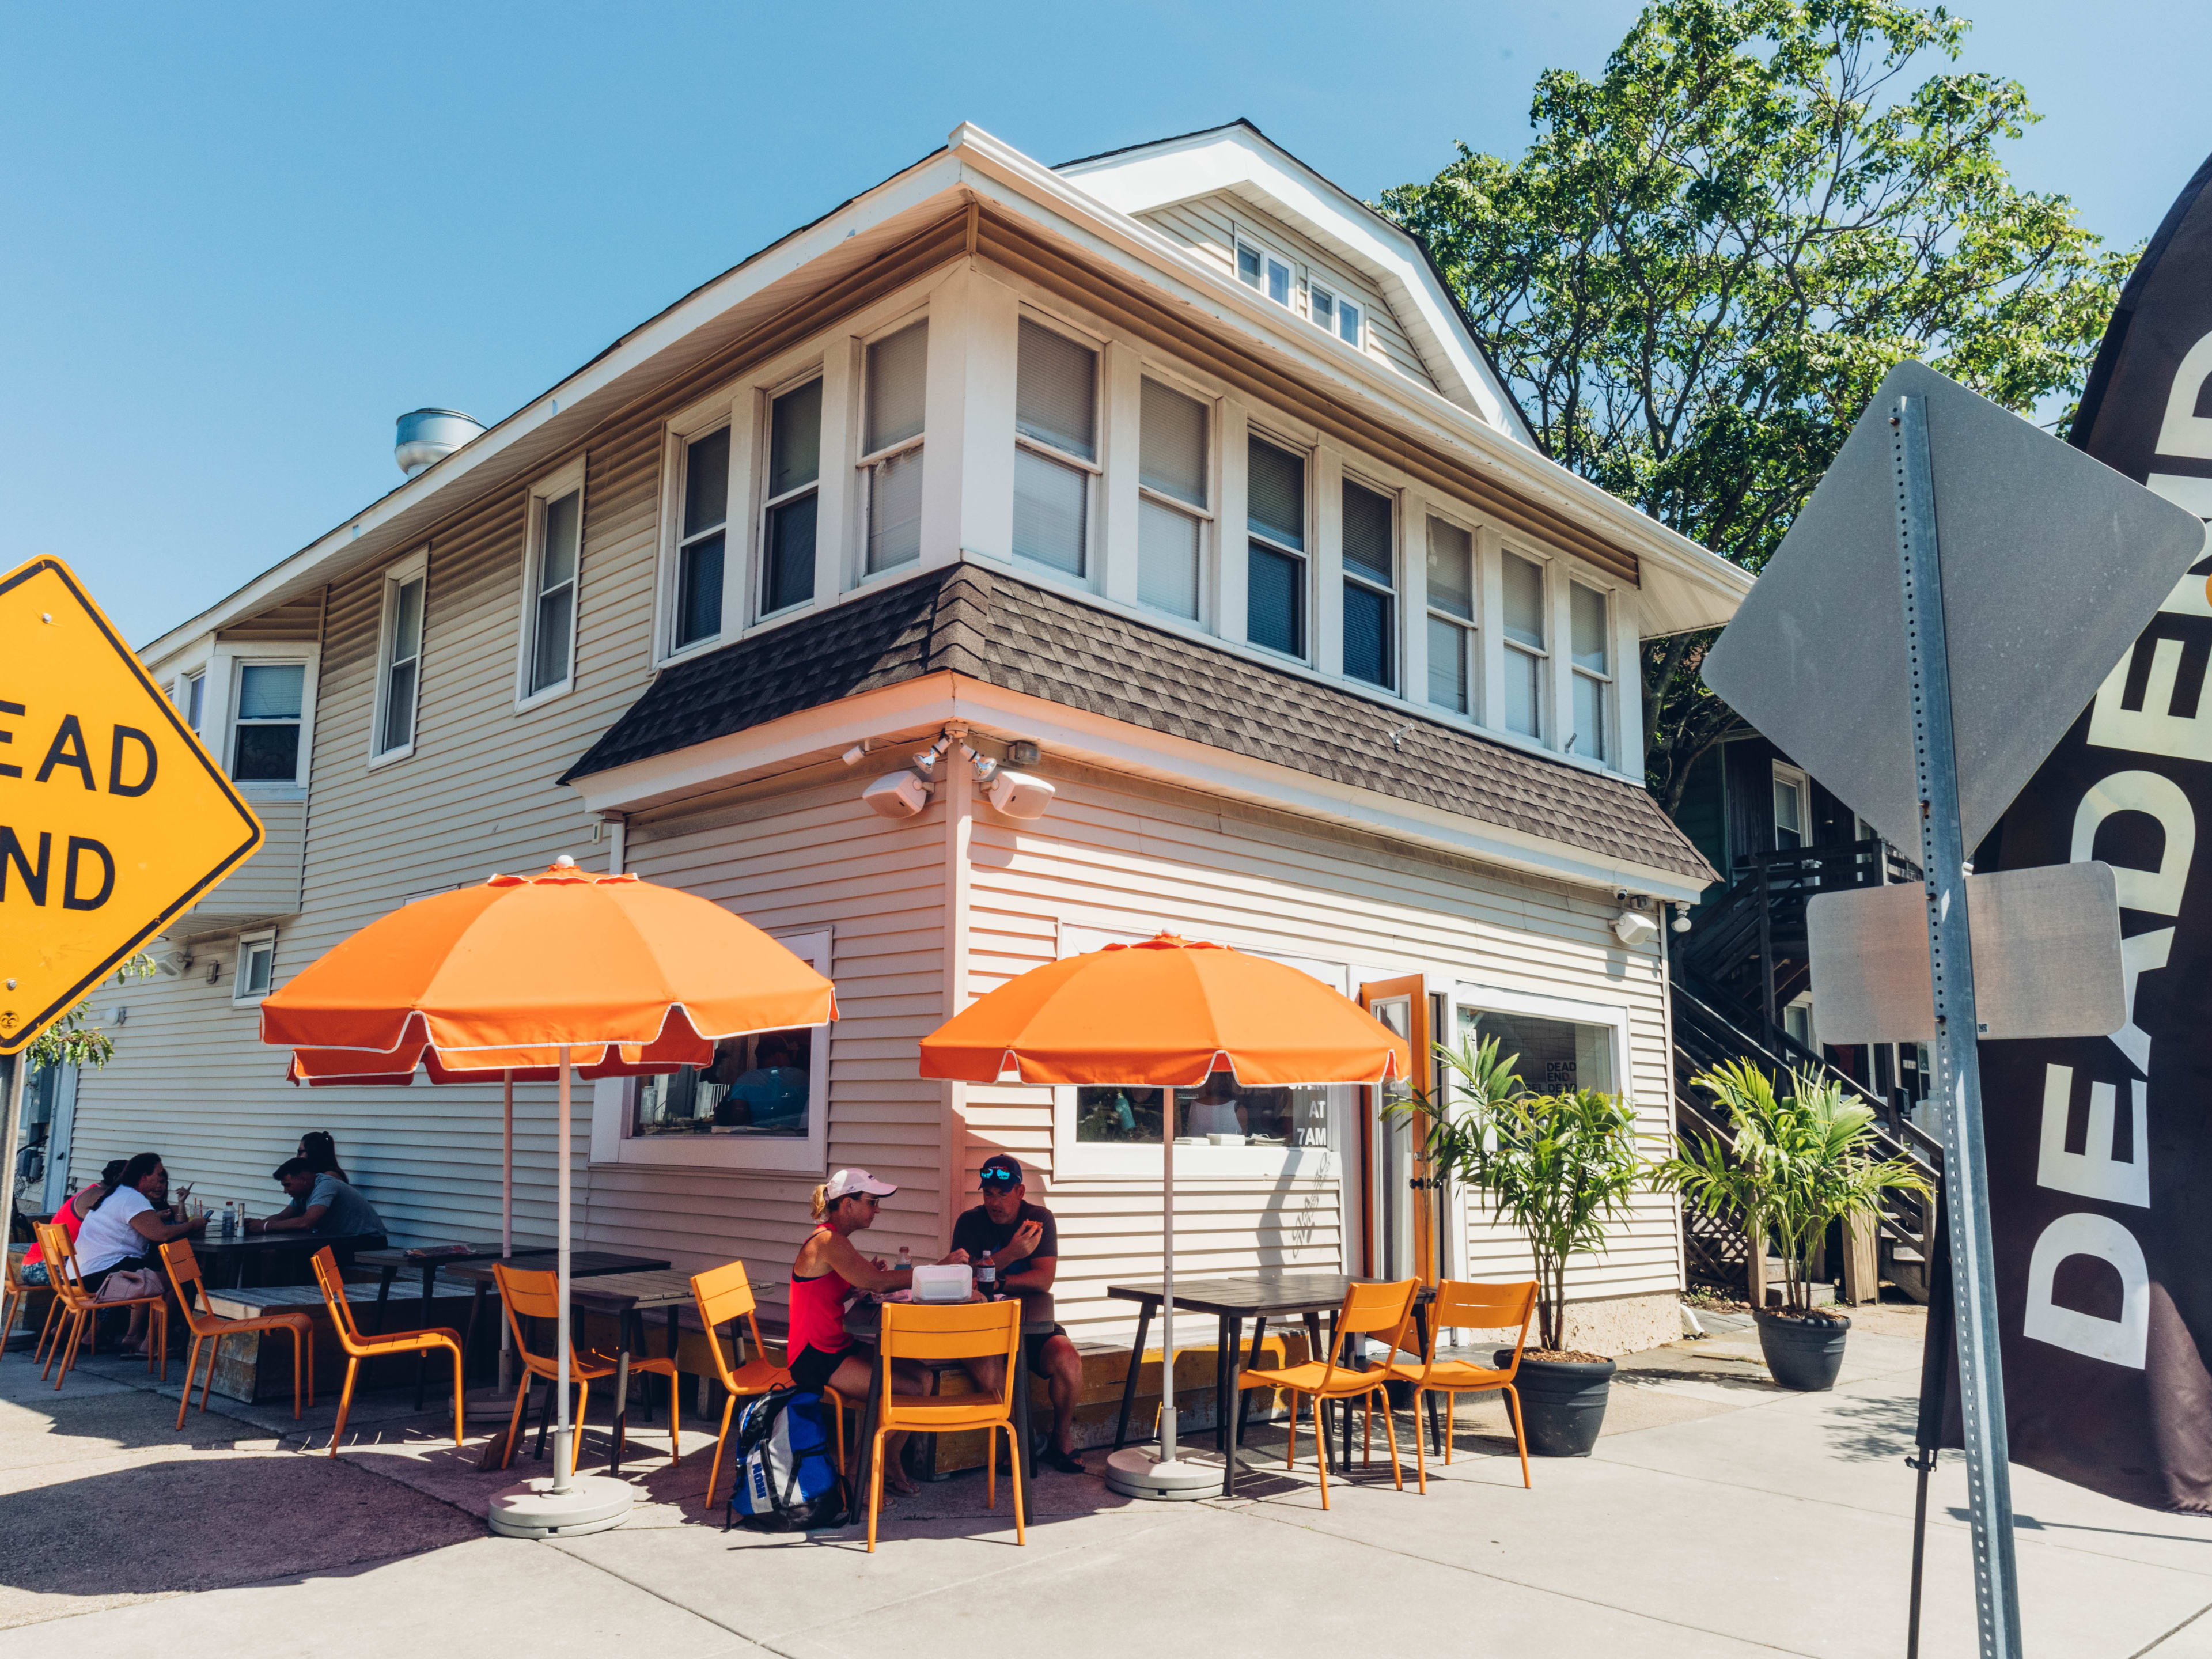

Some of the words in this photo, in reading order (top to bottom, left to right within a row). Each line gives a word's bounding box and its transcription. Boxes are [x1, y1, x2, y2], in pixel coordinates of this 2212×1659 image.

[0, 825, 115, 911] ND
[1546, 1062, 1577, 1071] DEAD
[1308, 1101, 1325, 1118] AT
[1297, 1127, 1327, 1146] 7AM
